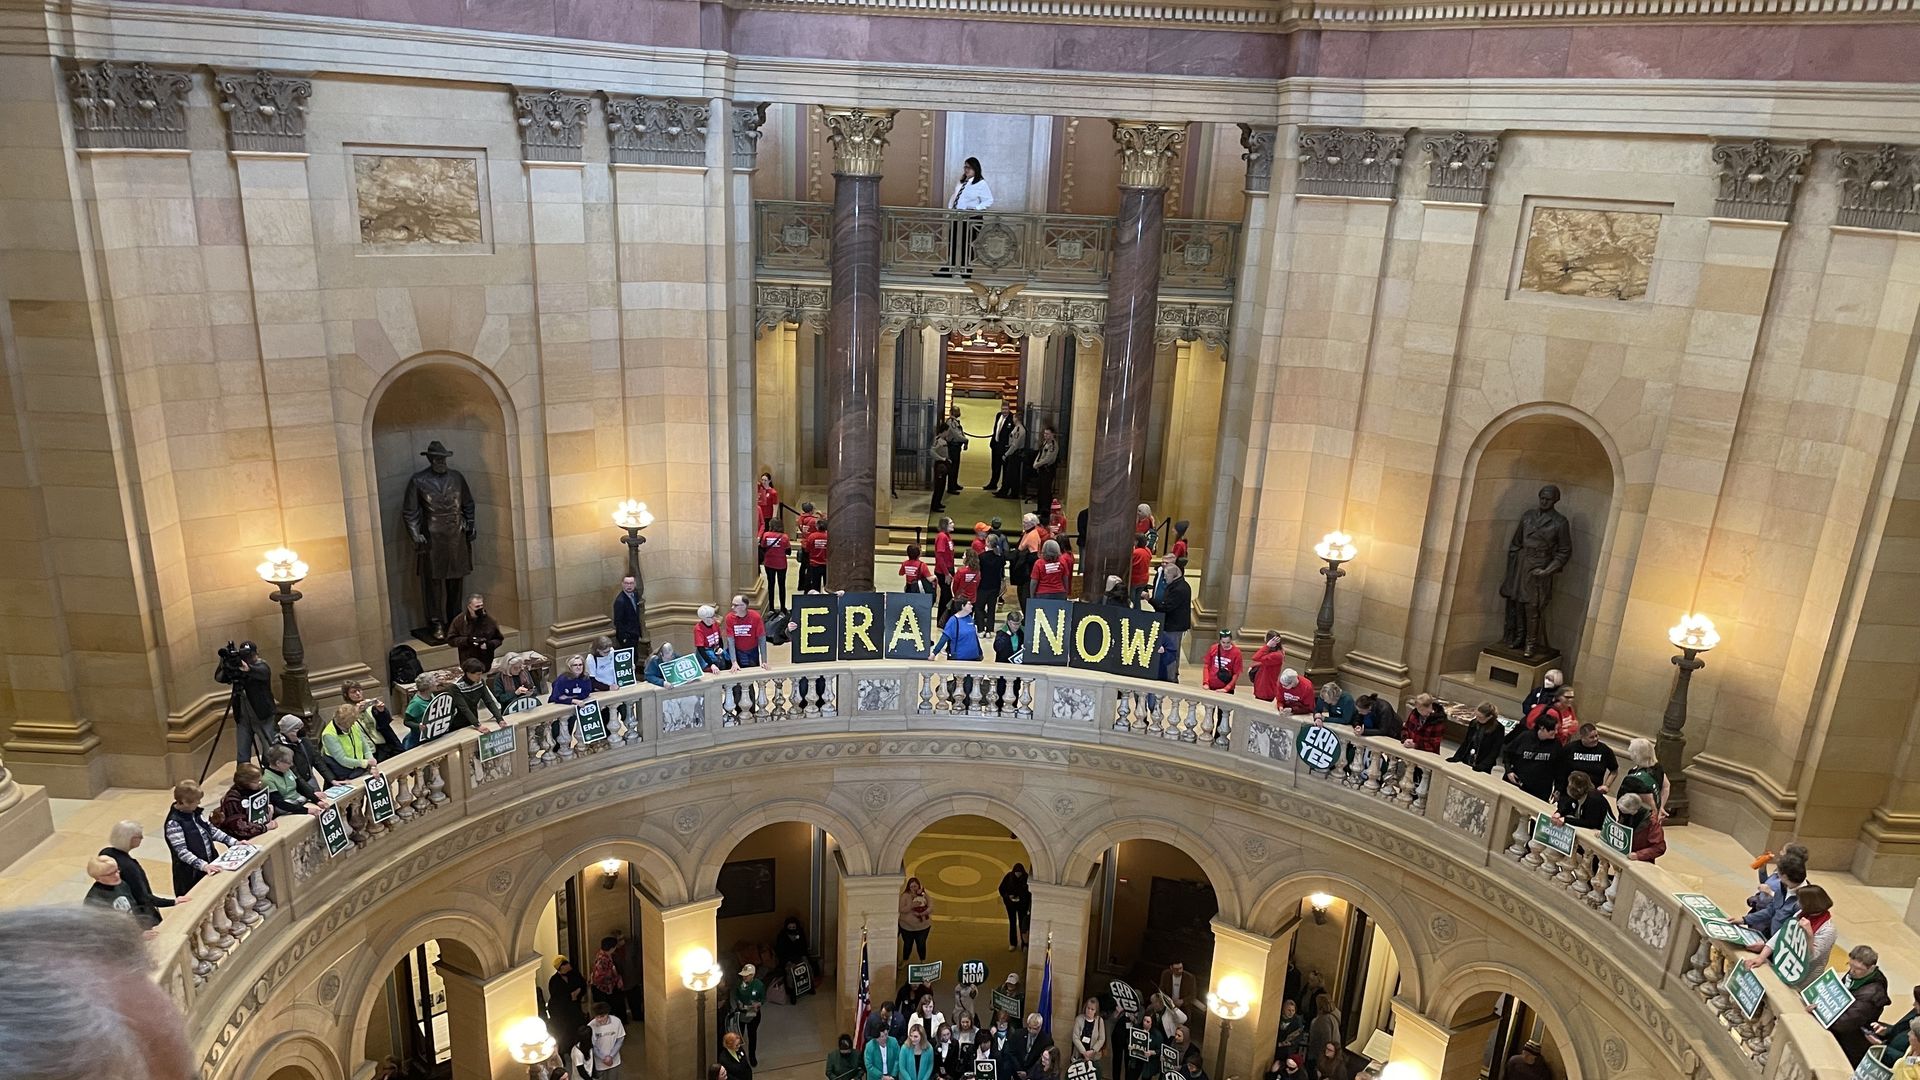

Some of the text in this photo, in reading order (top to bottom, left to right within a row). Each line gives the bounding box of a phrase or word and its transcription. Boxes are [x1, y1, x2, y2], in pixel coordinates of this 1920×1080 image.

[800, 605, 1161, 668] ERA NOW
[616, 668, 632, 677] ERA!
[429, 694, 453, 721] ERA
[426, 715, 452, 739] YES
[583, 720, 600, 731] ERA!
[1304, 726, 1339, 755] ERA
[1300, 741, 1333, 769] YES
[373, 796, 389, 810] ERA!
[327, 827, 343, 844] ERA!
[1541, 824, 1572, 844] EQUALITY
[1550, 837, 1570, 852] VOTER
[1784, 919, 1808, 962] ERA
[962, 962, 984, 974] ERA
[1774, 940, 1804, 982] YES
[962, 974, 984, 984] NOW
[1110, 982, 1133, 999] ERA
[1816, 979, 1841, 1013] EQUALITY
[1113, 996, 1138, 1011] YES
[1813, 996, 1833, 1019] VOTER
[1068, 1060, 1097, 1078] YES
